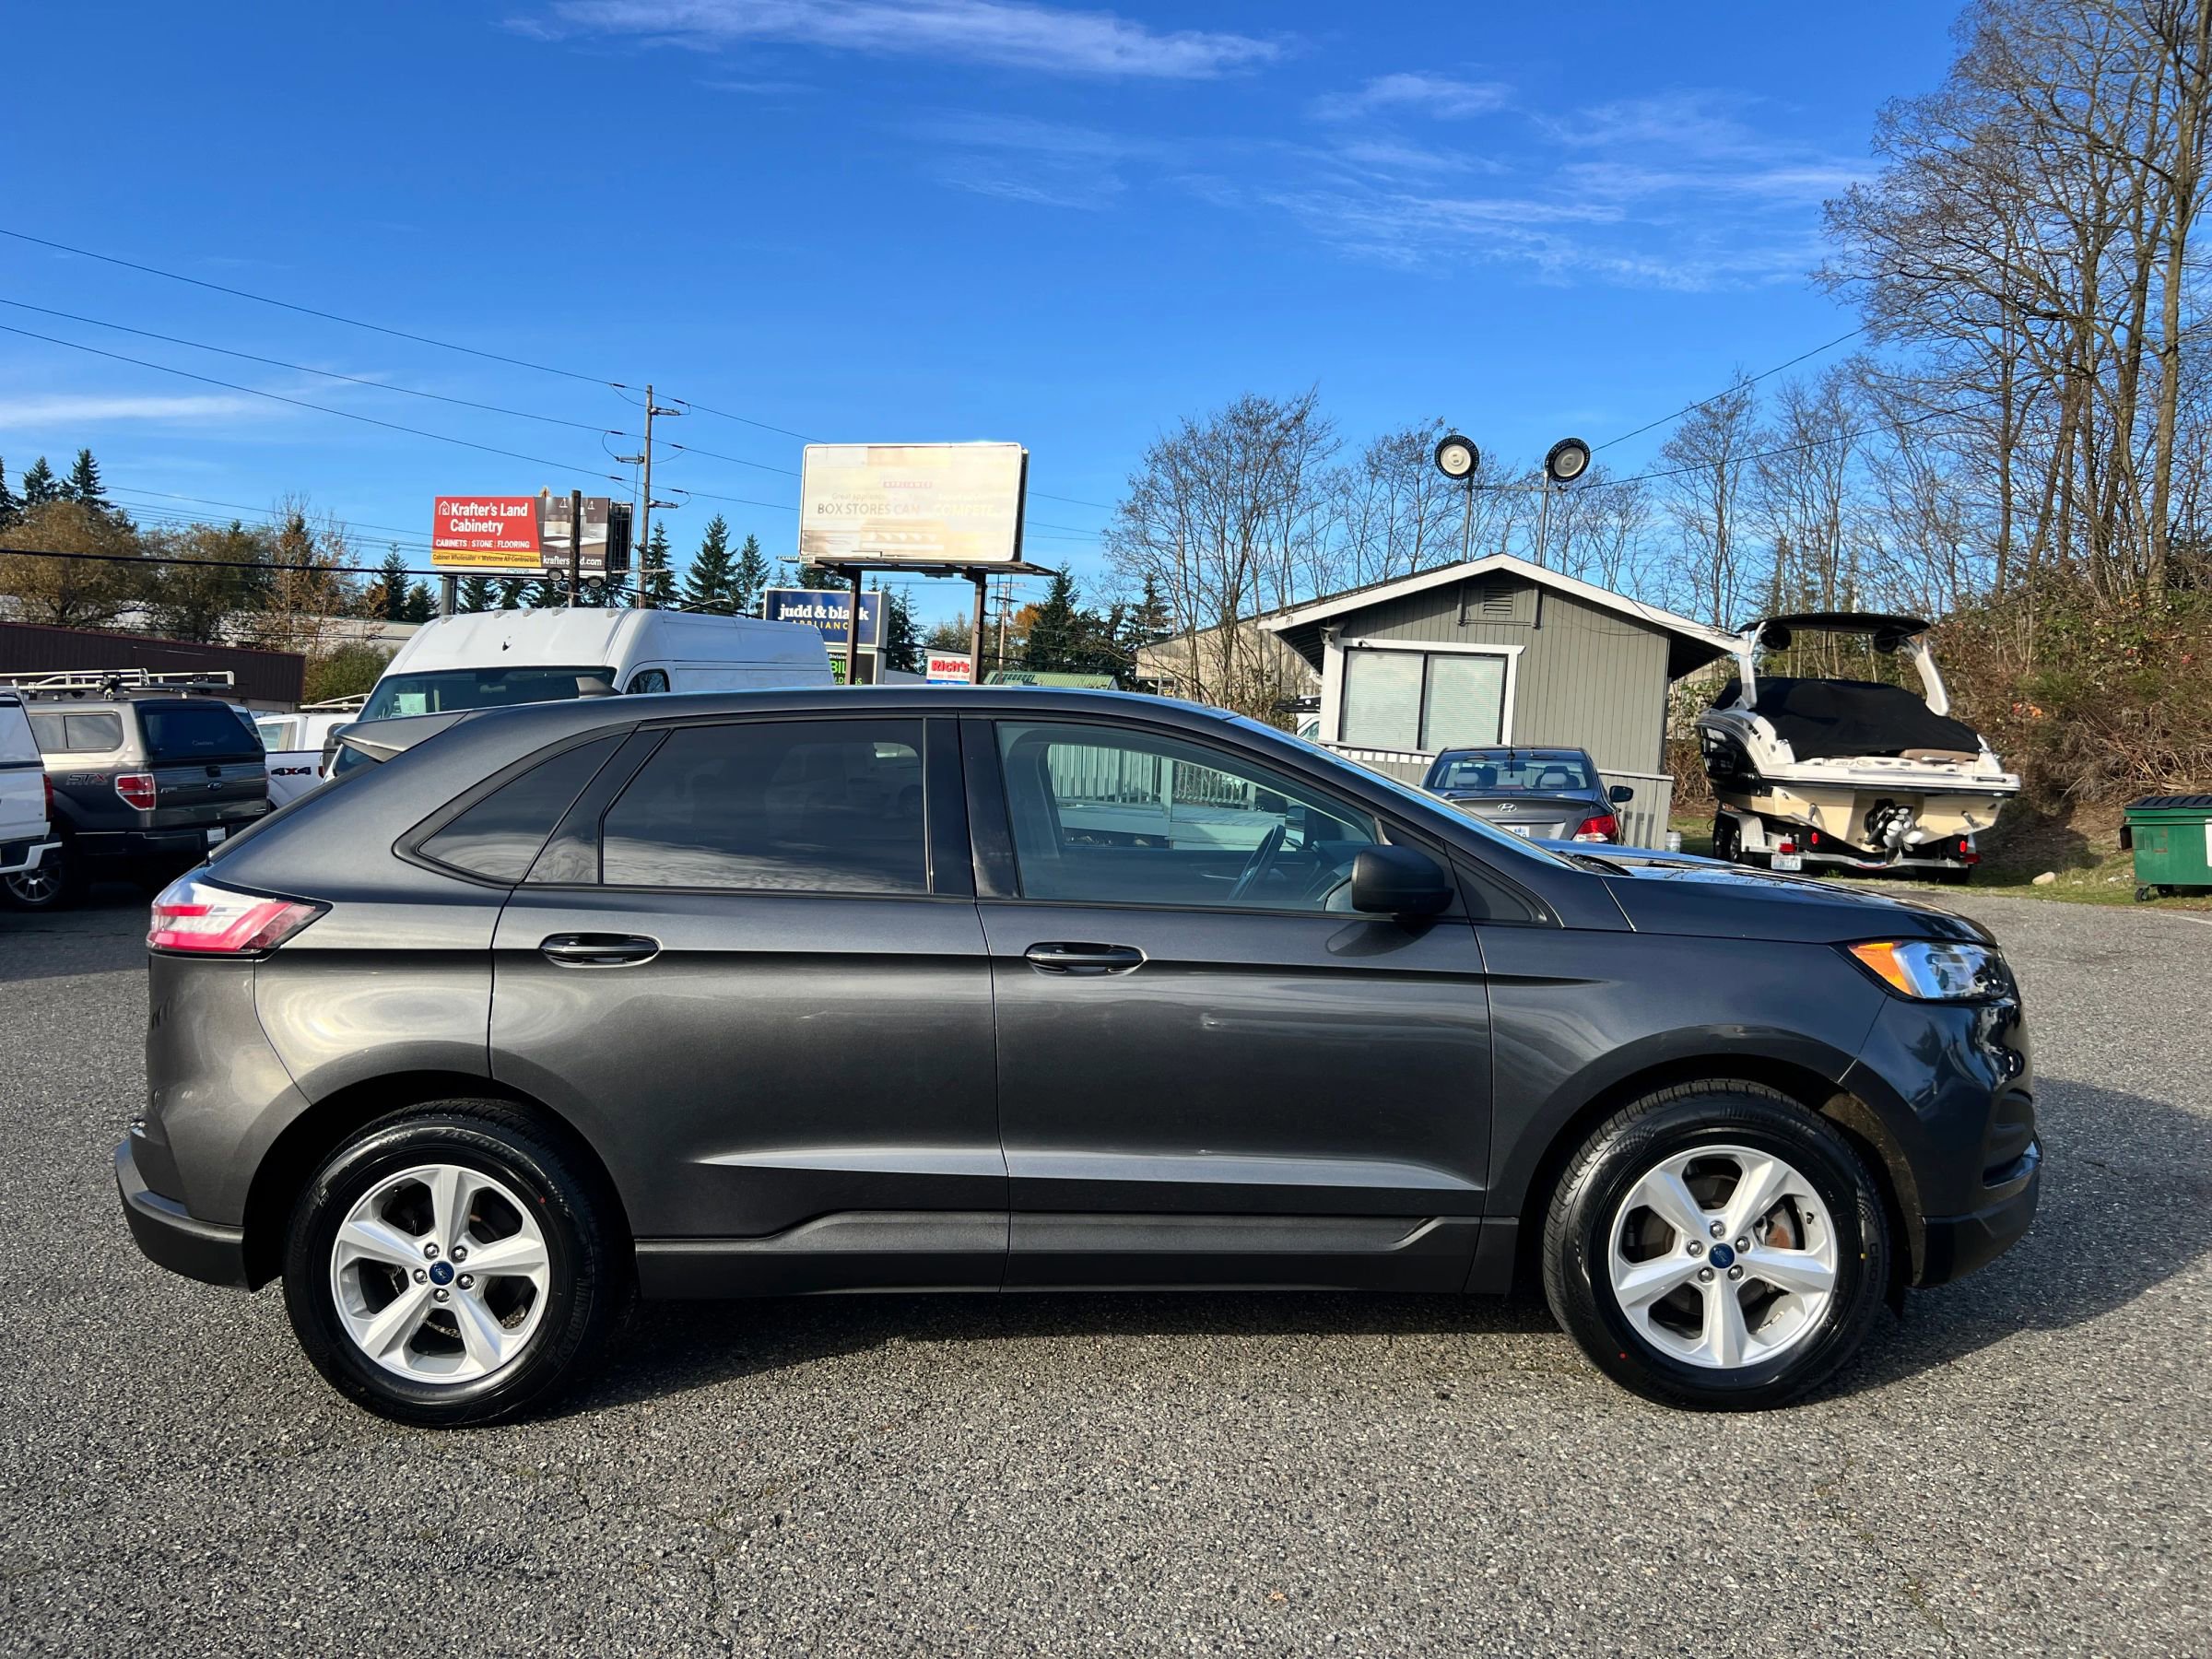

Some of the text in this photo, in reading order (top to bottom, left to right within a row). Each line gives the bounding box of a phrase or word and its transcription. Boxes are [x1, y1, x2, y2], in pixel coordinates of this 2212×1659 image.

[452, 502, 498, 516] Krafter's
[500, 502, 528, 516] Land
[818, 502, 842, 514] BOX
[846, 502, 890, 514] STORES
[450, 518, 504, 535] Cabinetry
[436, 539, 530, 549] CABINETS STONE FLOORING
[543, 555, 602, 566] kraftersd.com
[778, 604, 869, 620] judd & blak
[932, 660, 970, 673] Rich's
